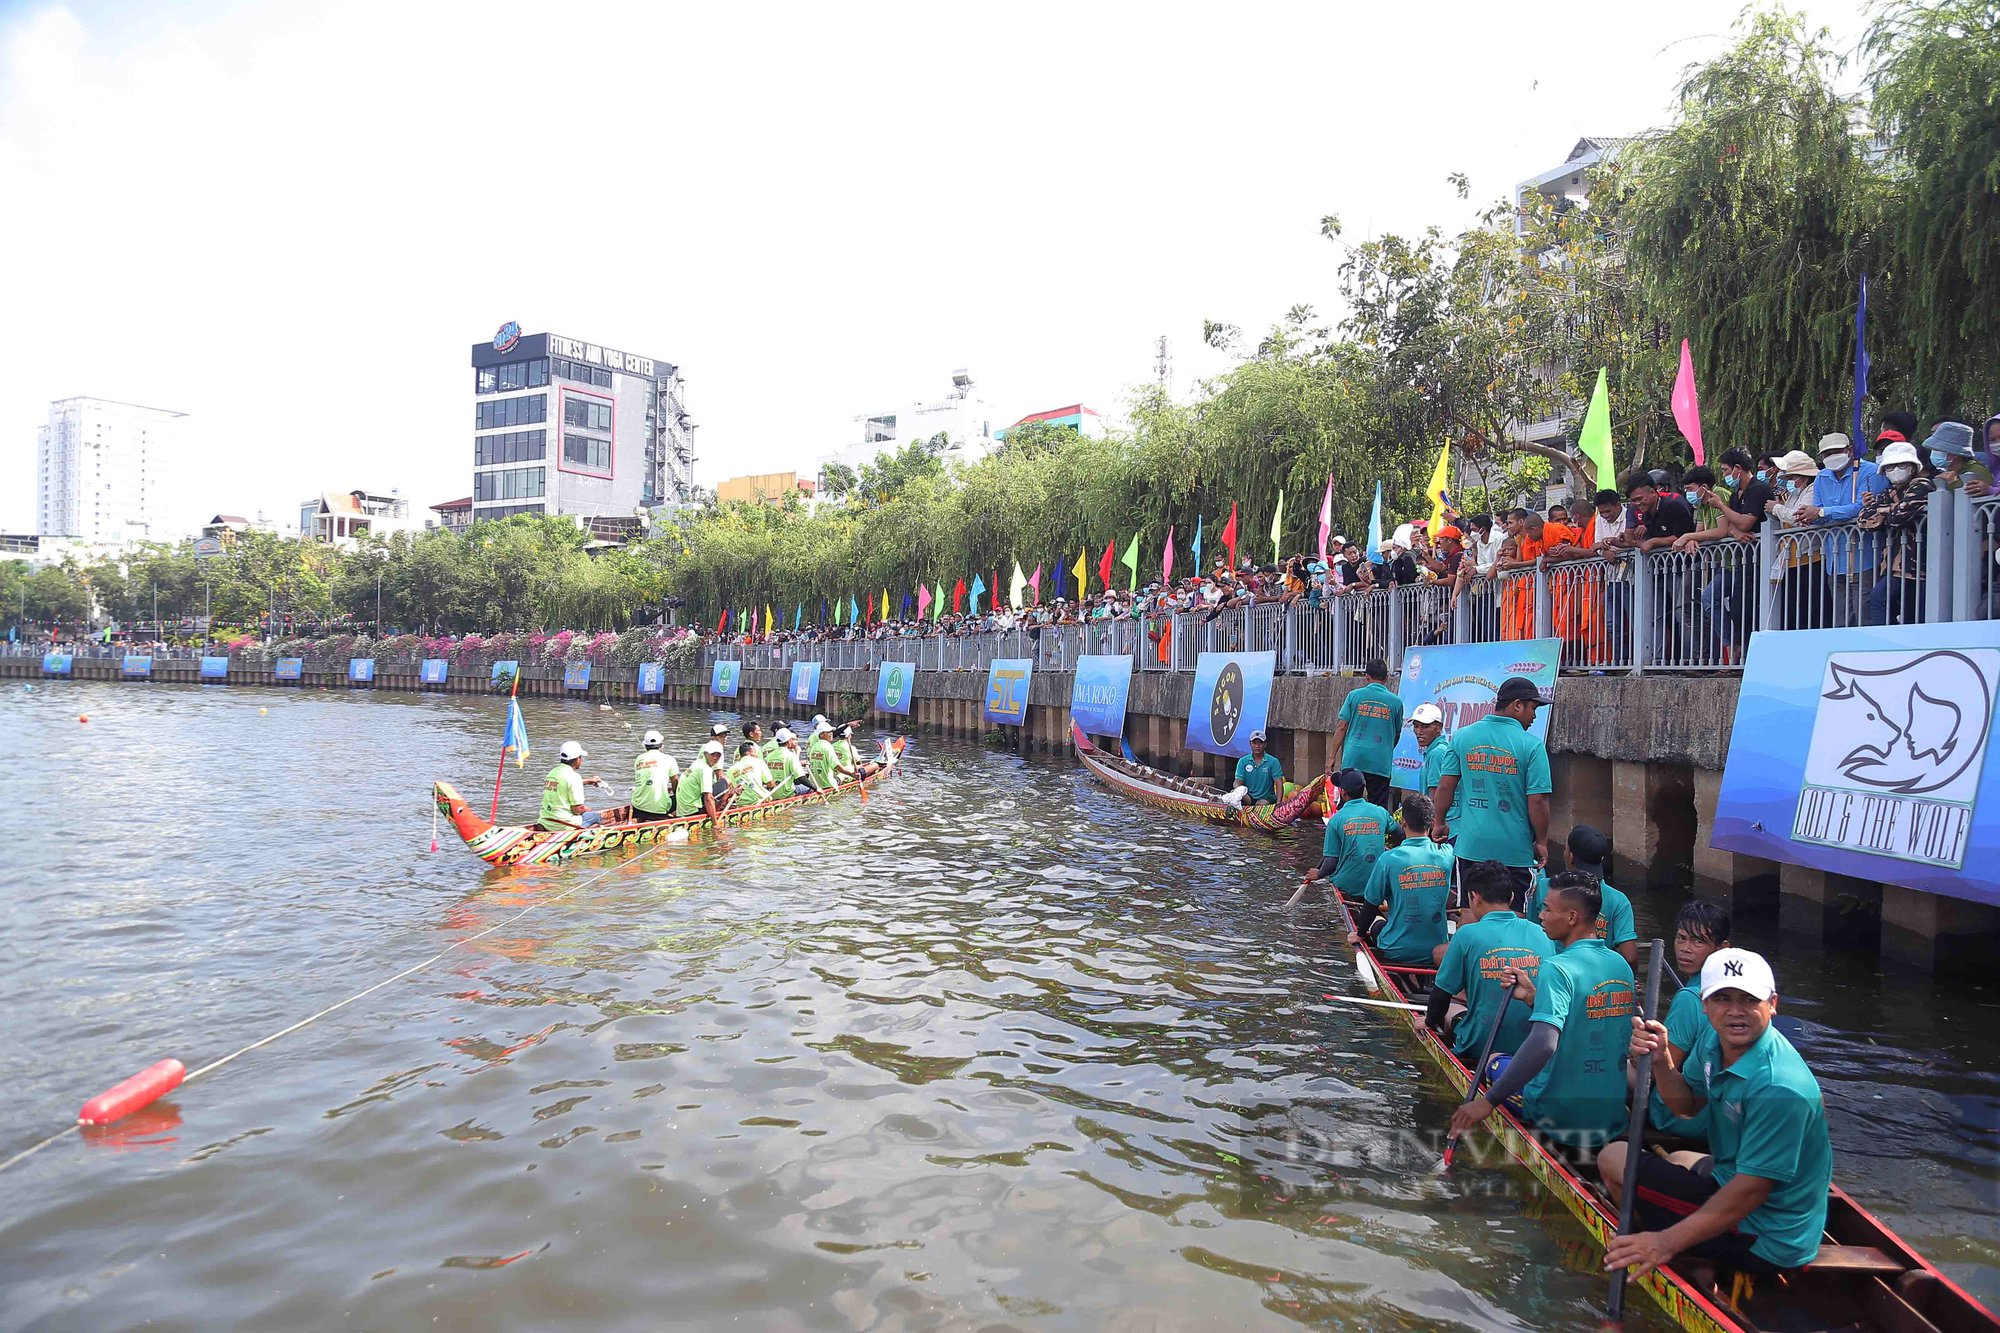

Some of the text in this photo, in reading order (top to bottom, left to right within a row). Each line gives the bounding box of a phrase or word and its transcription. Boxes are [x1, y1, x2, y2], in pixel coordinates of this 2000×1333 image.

[549, 334, 654, 377] FITNESS AND YOGA CENTER
[989, 669, 1025, 714] STC
[1091, 685, 1117, 706] KOKO
[1469, 797, 1488, 809] STC
[1795, 788, 1971, 862] LOLI & THE WOLF
[1724, 959, 1743, 977] NY
